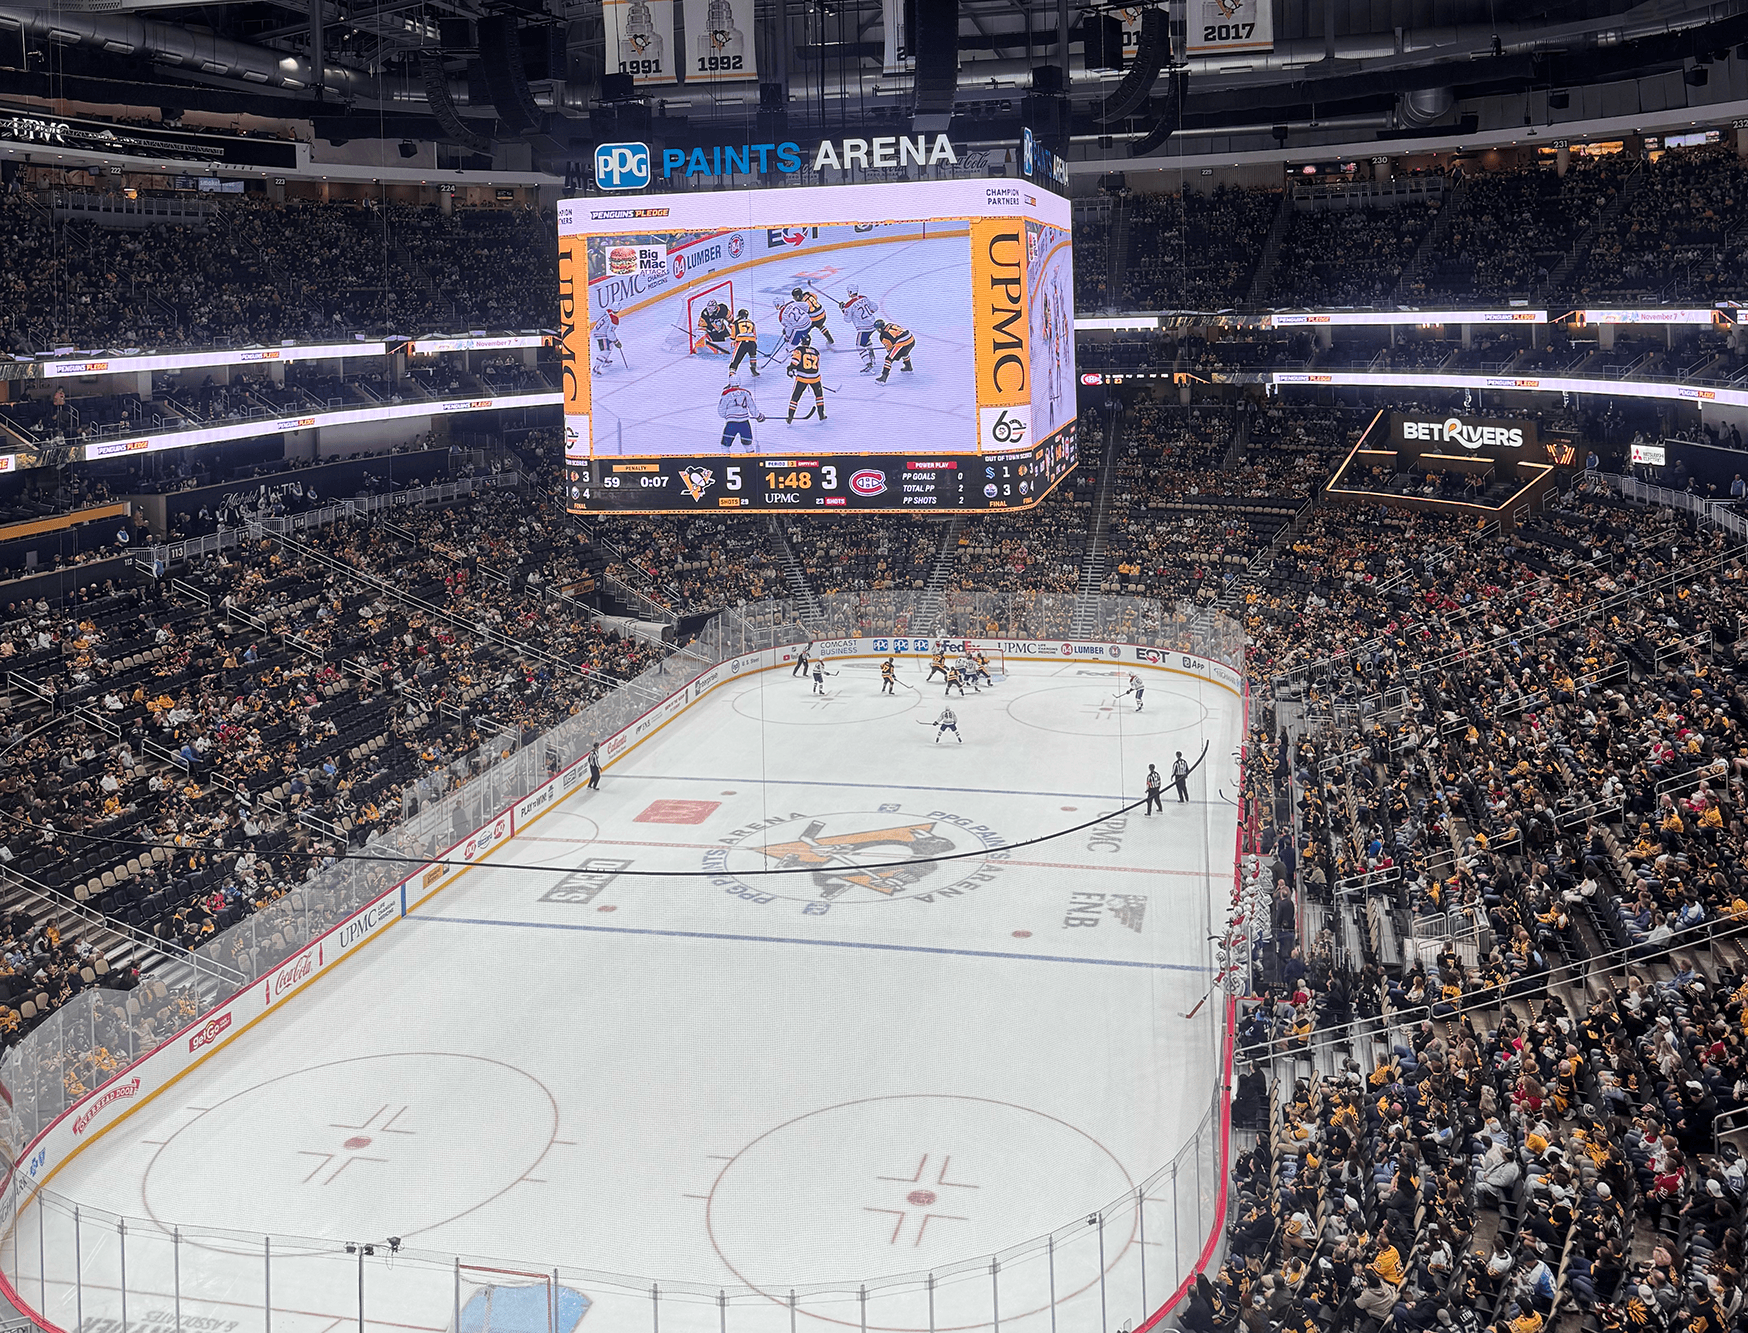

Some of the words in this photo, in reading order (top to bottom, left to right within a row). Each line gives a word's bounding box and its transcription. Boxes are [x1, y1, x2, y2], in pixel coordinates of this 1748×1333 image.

[1203, 23, 1255, 41] 2017
[618, 59, 662, 75] 1991
[698, 55, 743, 72] 1992
[1732, 119, 1748, 129] 232
[1552, 140, 1569, 149] 231
[598, 149, 646, 184] PPG
[663, 142, 802, 178] PAINTS
[813, 133, 958, 171] ARENA
[1371, 156, 1388, 164] 230
[275, 178, 286, 186] 223
[440, 184, 456, 192] 224
[986, 189, 1019, 197] CHAMPION
[987, 197, 1019, 205] PARTNERS
[591, 210, 634, 220] PENGUINS
[635, 208, 670, 218] PLEDGE
[639, 249, 658, 261] Big
[686, 245, 722, 270] LUMBER
[640, 259, 666, 269] Mac
[597, 275, 646, 308] UPMC
[789, 306, 802, 323] 22
[988, 230, 1026, 394] UPMC
[1640, 313, 1672, 321] November
[1672, 312, 1678, 320] 7
[476, 340, 506, 348] November
[802, 354, 818, 370] 67
[1403, 418, 1524, 448] BETRIVERS
[582, 472, 590, 482] 3
[821, 466, 838, 490] 3
[902, 472, 912, 481] PP
[912, 472, 936, 481] GOALS
[958, 472, 963, 480] 0
[1002, 466, 1010, 478] 1
[604, 476, 620, 488] 59
[640, 476, 670, 488] 0:07
[726, 466, 742, 491] 5
[765, 472, 812, 490] 1:48
[582, 488, 590, 499] 4
[902, 484, 924, 492] TOTAL
[924, 484, 935, 492] PP
[958, 484, 964, 492] 2
[1003, 484, 1012, 496] 3
[394, 494, 406, 504] 115
[764, 493, 800, 504] UPMC
[826, 498, 846, 506] SHOTS
[902, 496, 912, 504] PP
[913, 496, 938, 504] SHOTS
[958, 496, 964, 504] 2
[989, 500, 1008, 508] FINAL
[336, 508, 345, 518] 114
[294, 518, 305, 528] 114
[172, 546, 184, 558] 113
[124, 558, 133, 566] 112
[820, 640, 858, 650] COMCAST
[820, 646, 858, 656] BUSINESS
[874, 640, 888, 650] PPG
[894, 640, 909, 650] PPG
[914, 640, 929, 650] PPG
[998, 642, 1036, 654] UPMC
[1062, 645, 1072, 654] 84
[1074, 644, 1104, 655] LUMBER
[1136, 648, 1170, 663] EQT
[520, 800, 533, 818] PLAY
[926, 810, 974, 827] PPG
[718, 812, 808, 845] ARENA
[913, 862, 1004, 905] ARENA
[726, 884, 776, 904] PPG
[340, 908, 378, 948] UPMC
[275, 951, 314, 996] Coca-Cola
[192, 1024, 220, 1050] getGo
[79, 1093, 114, 1131] OVERHEAD
